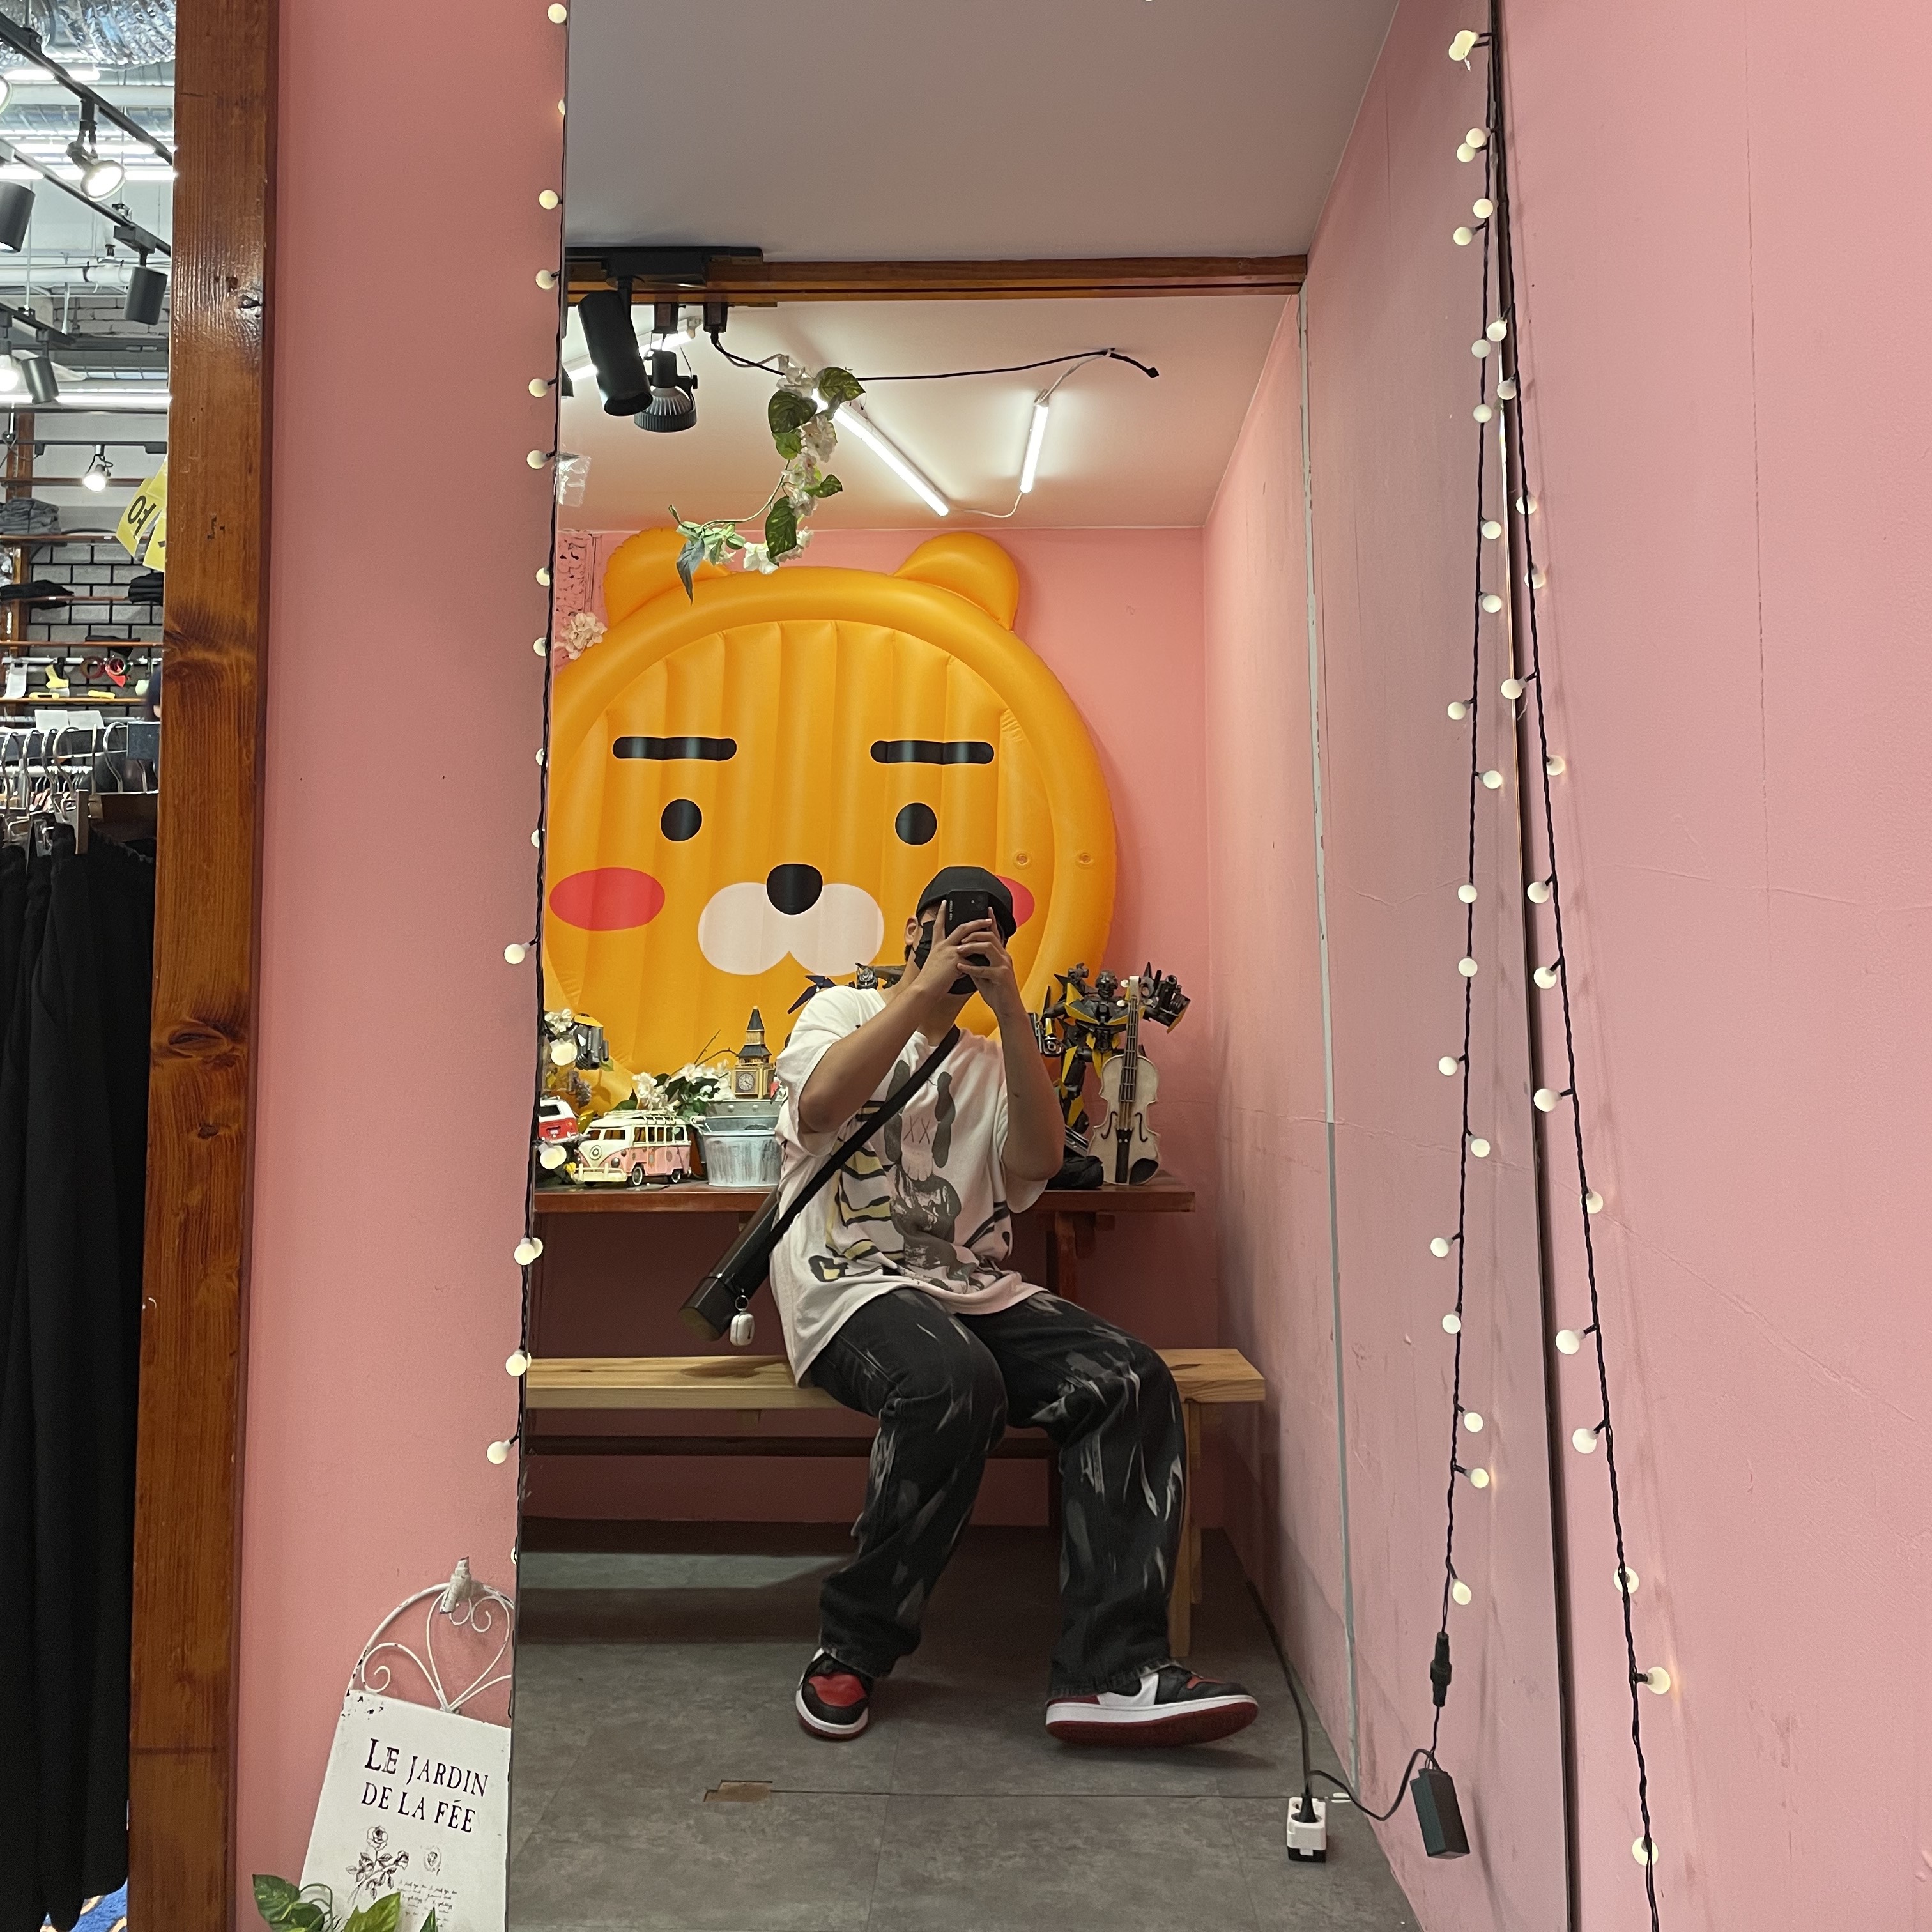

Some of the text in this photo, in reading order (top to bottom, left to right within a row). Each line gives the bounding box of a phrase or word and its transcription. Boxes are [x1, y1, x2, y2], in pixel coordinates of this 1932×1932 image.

[364, 1738, 489, 1797] LE JARDIN
[360, 1781, 477, 1833] DE LA FÉE
